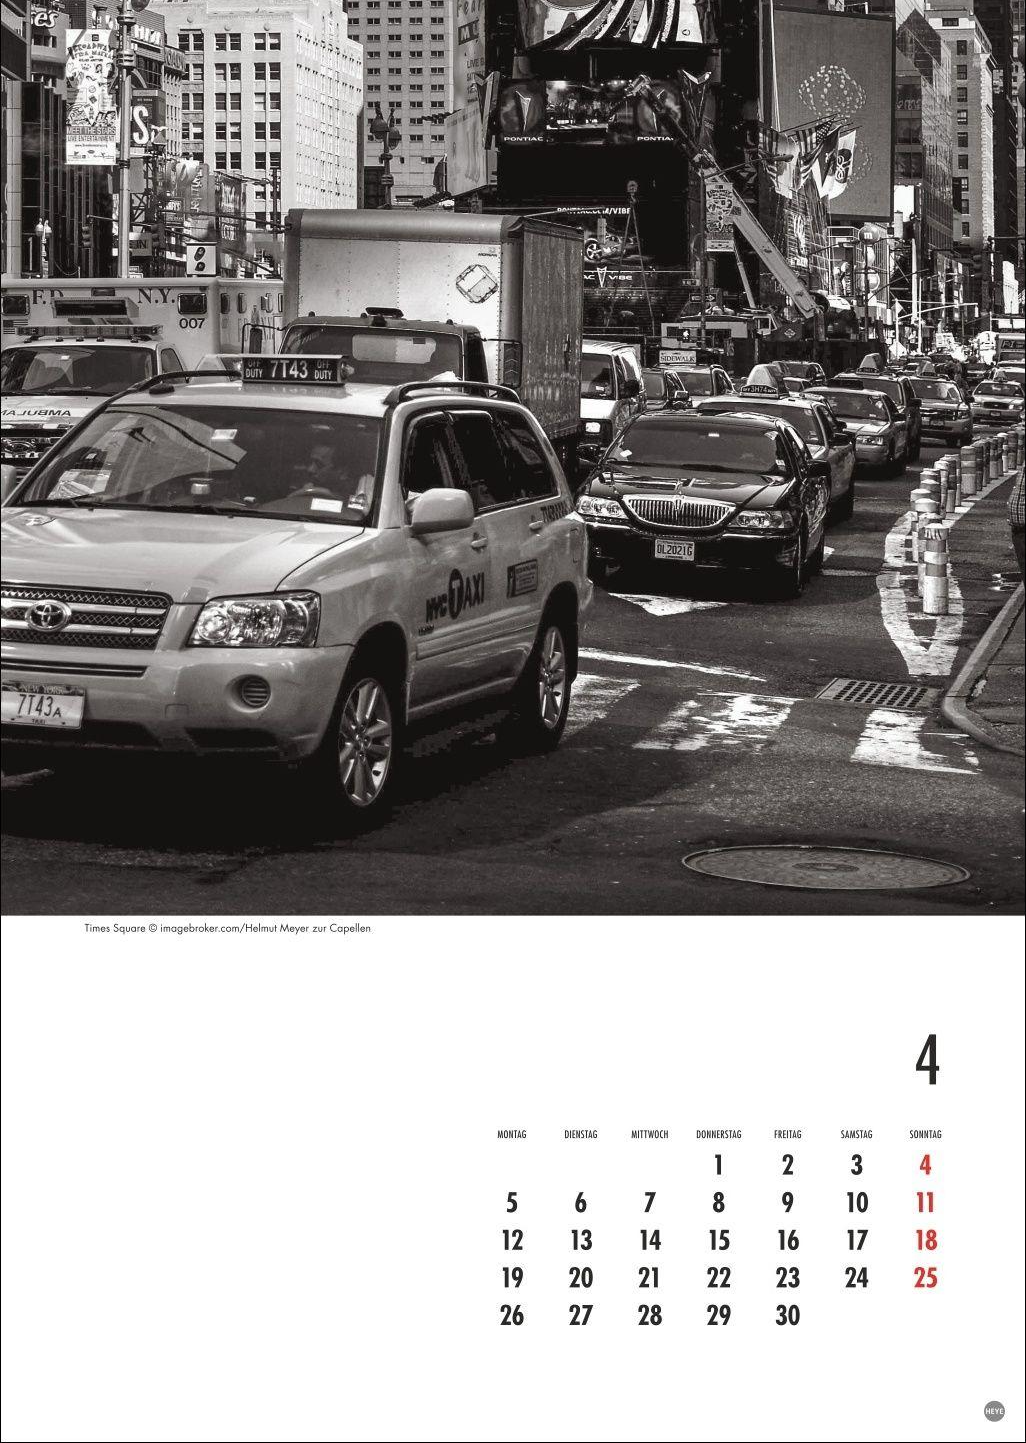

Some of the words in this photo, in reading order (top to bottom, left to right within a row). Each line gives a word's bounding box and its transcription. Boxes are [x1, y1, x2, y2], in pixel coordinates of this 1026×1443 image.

[179, 318, 205, 329] 007
[245, 369, 263, 378] DUTY
[270, 359, 309, 378] 7T43
[314, 370, 333, 380] DUTY
